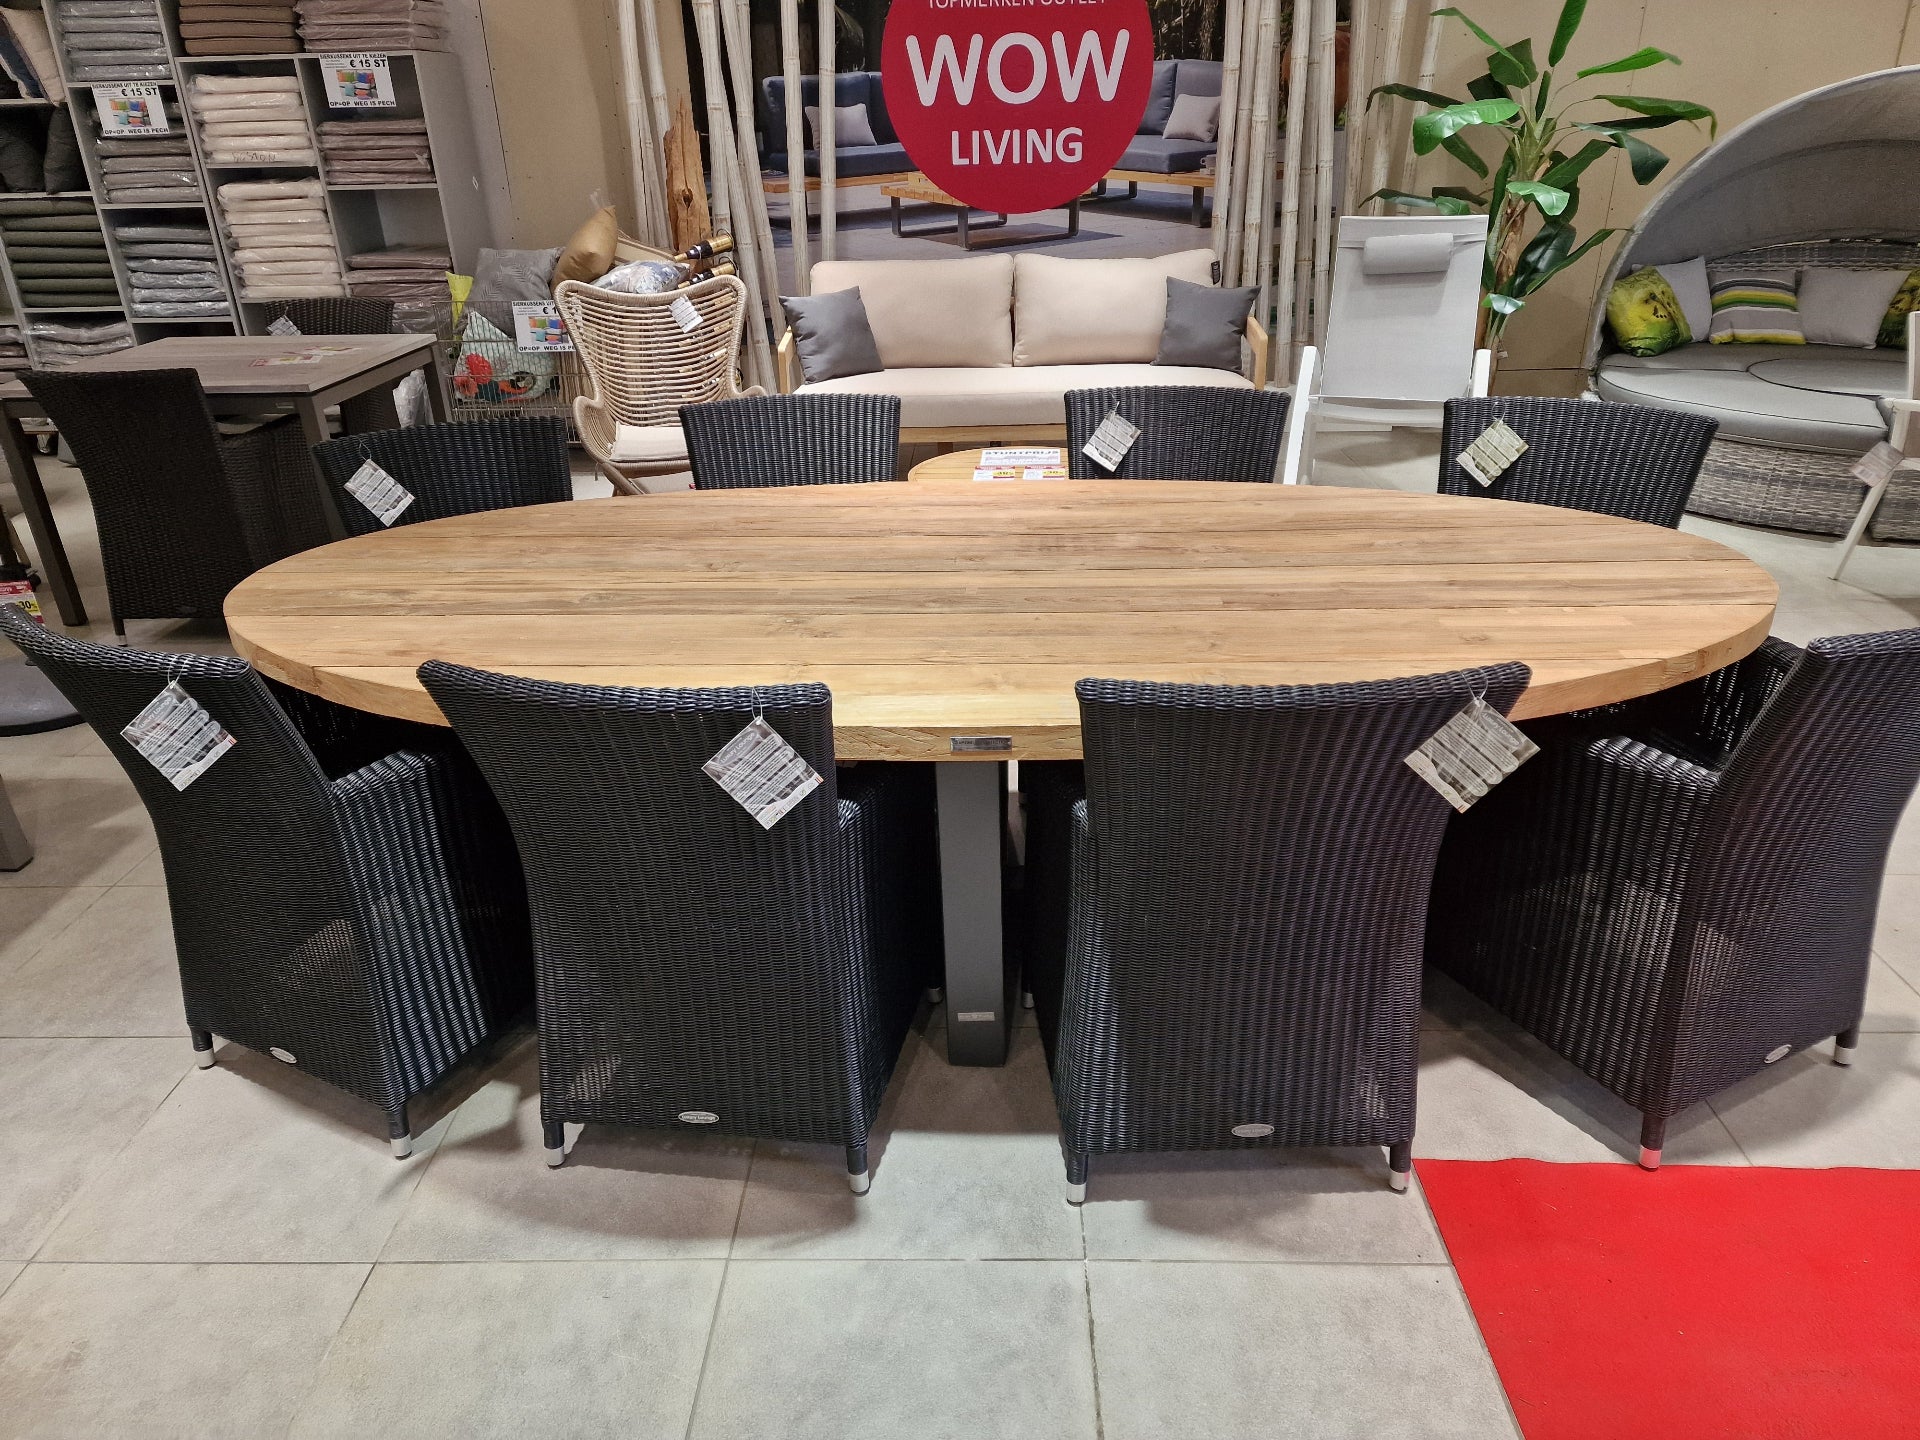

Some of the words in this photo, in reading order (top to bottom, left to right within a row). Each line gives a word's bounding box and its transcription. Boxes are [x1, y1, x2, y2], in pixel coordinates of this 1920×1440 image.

[349, 59, 356, 68] €
[359, 59, 371, 68] 15
[374, 59, 387, 68] ST
[905, 28, 1130, 107] WOW
[121, 88, 128, 97] €
[130, 88, 143, 96] 15
[144, 87, 157, 96] ST
[951, 126, 1083, 166] LIVING
[542, 306, 549, 315] €
